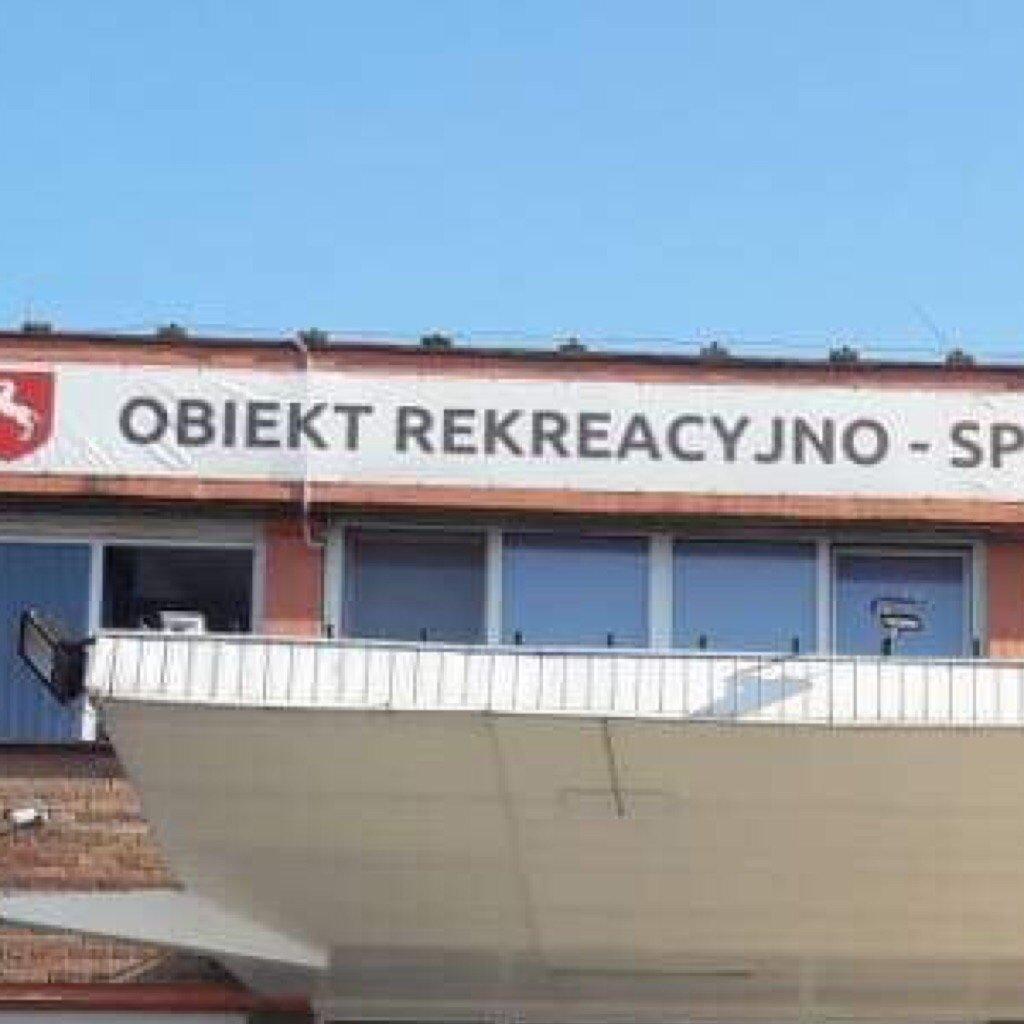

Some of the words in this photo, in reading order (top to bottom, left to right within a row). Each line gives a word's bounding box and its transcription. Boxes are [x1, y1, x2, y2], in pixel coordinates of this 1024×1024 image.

[119, 397, 373, 451] OBIEKT
[395, 405, 888, 466] REKREACYJNO
[910, 442, 930, 452] -
